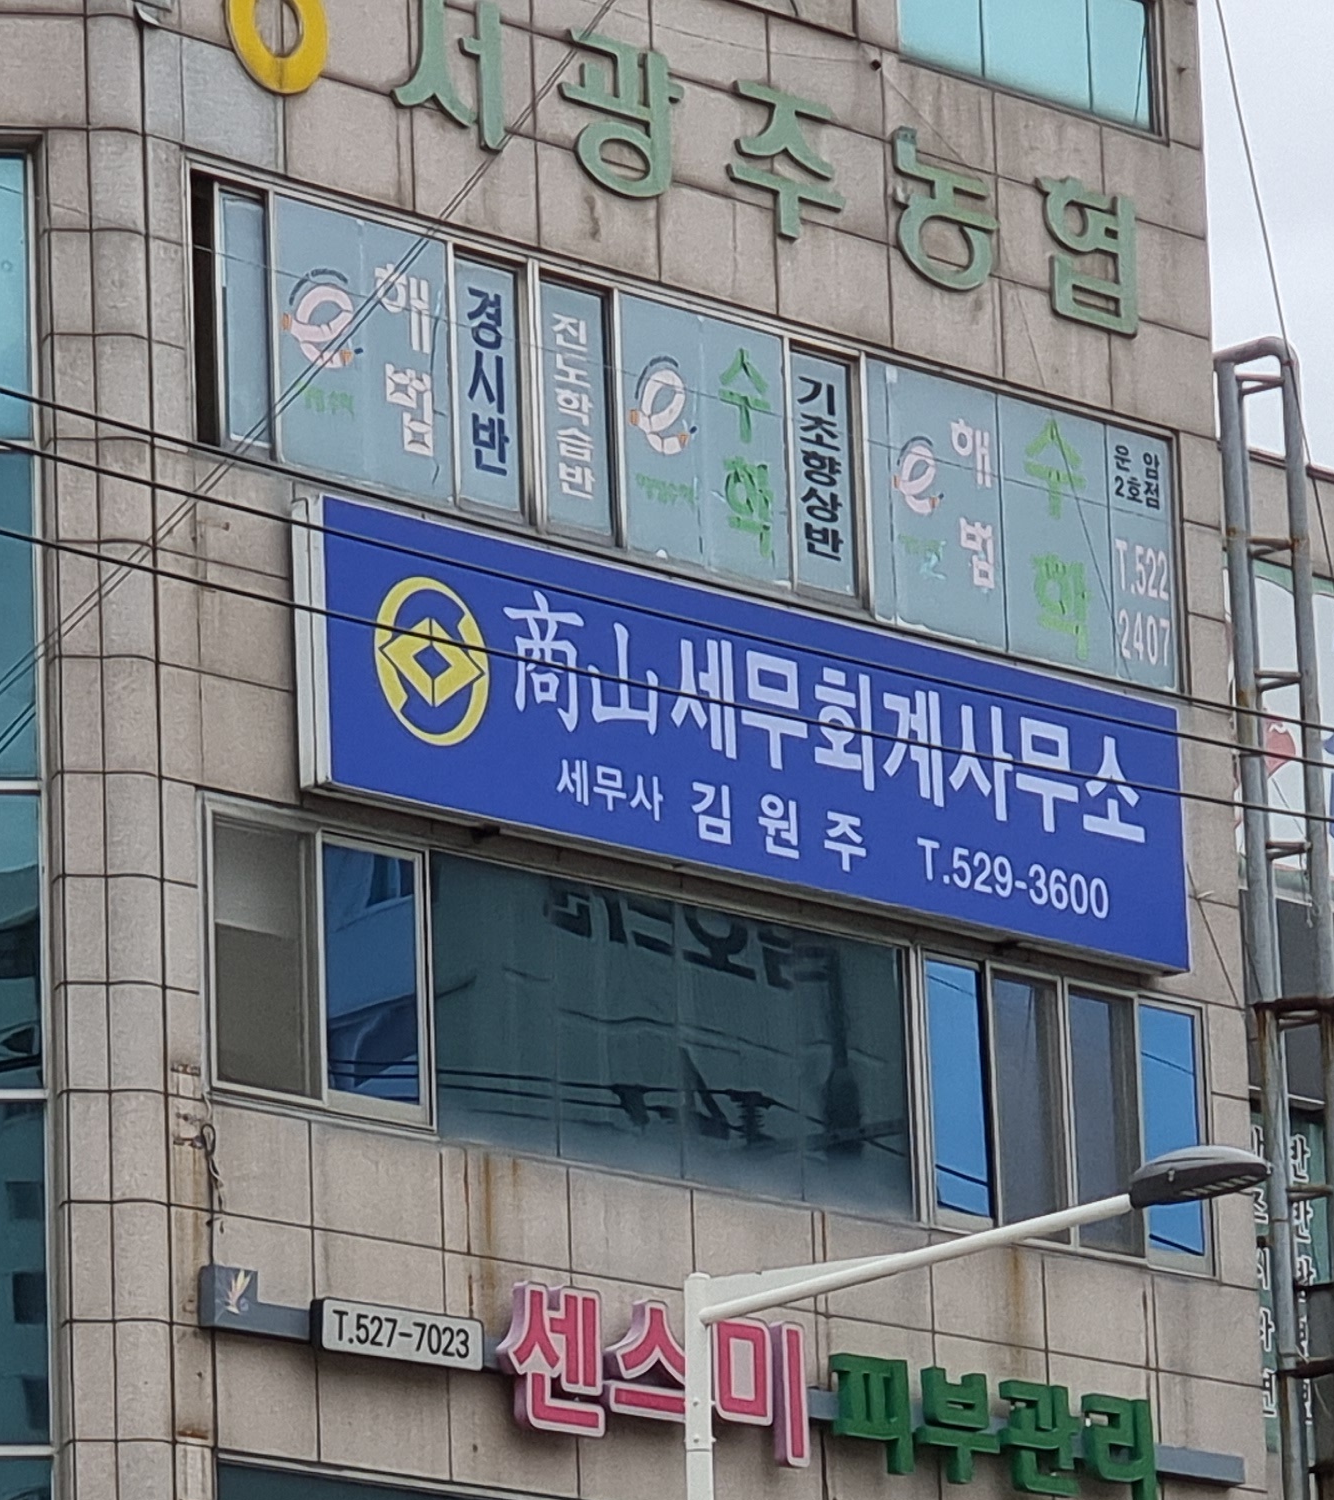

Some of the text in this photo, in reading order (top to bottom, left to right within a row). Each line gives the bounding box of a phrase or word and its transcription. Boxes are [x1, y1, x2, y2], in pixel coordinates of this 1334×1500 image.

[394, 0, 1138, 336] 서광주농협
[374, 263, 434, 457] 해법
[466, 286, 511, 477] 경시반
[798, 375, 844, 562] 기초향상반
[950, 419, 997, 590] 해법
[1114, 538, 1170, 602] T.522
[1117, 608, 1170, 668] 2407
[671, 636, 1147, 845] 세무회계사무소
[557, 758, 1110, 921] 세무사 김원주 T.529-3600
[332, 1309, 472, 1361] T.527-7023
[497, 1281, 811, 1469] 센스미
